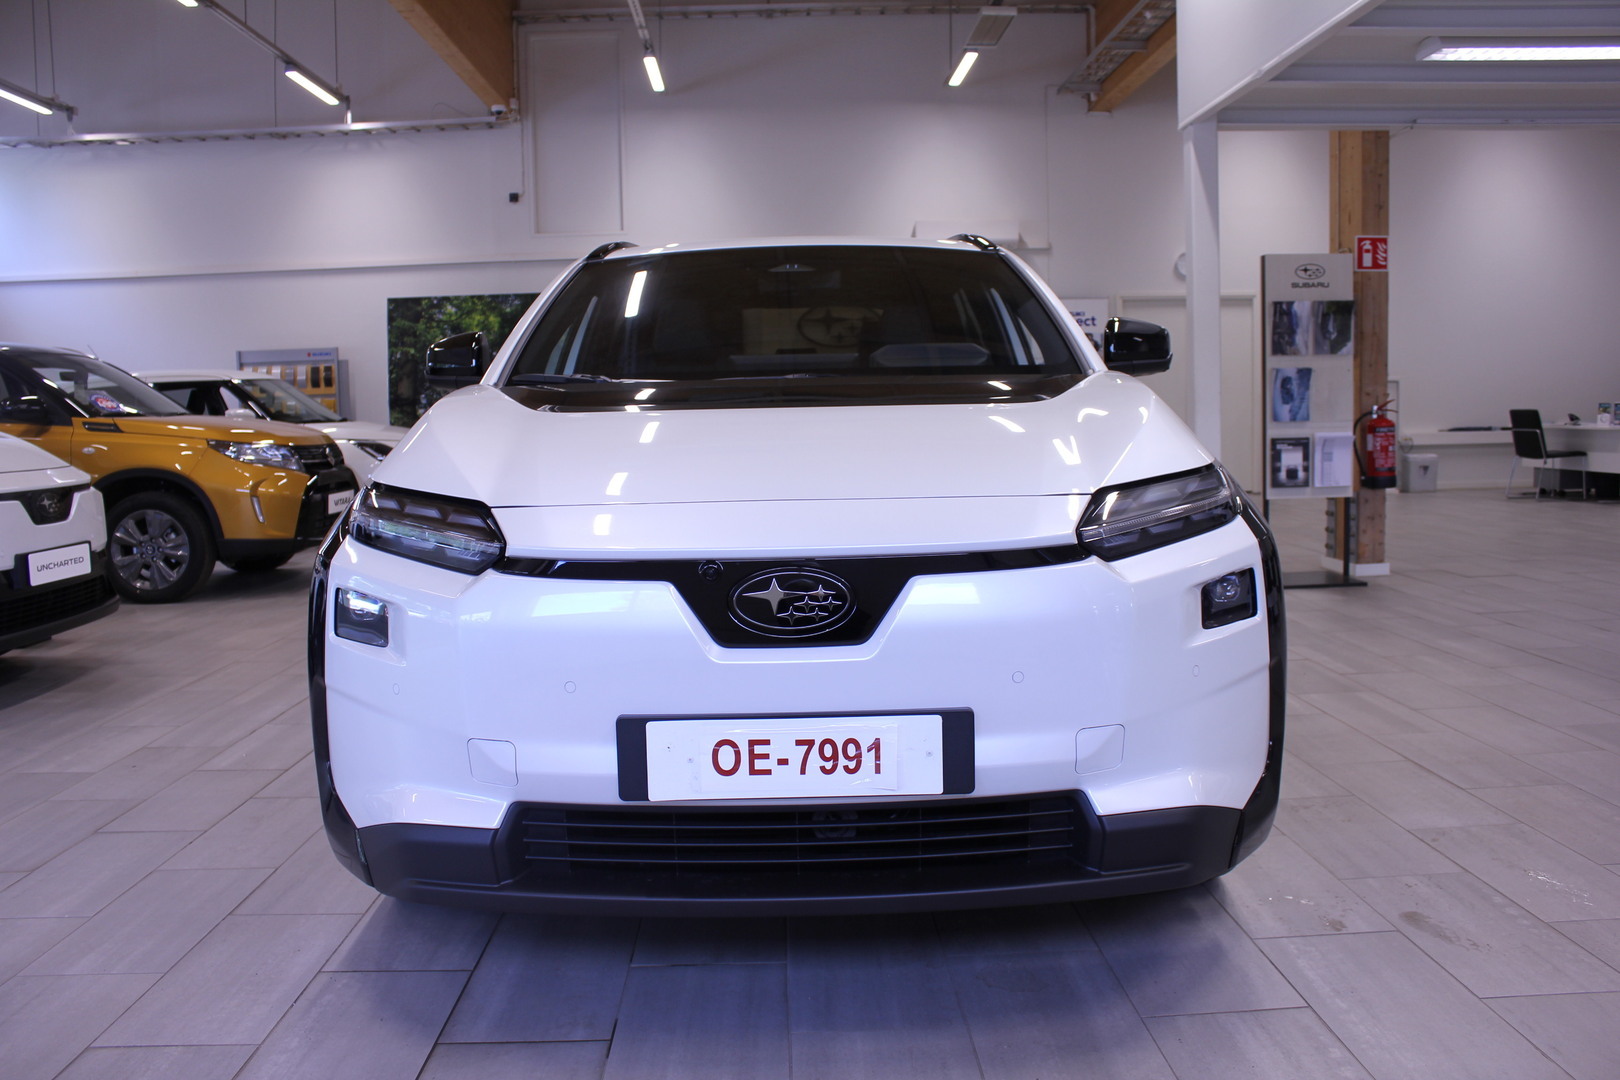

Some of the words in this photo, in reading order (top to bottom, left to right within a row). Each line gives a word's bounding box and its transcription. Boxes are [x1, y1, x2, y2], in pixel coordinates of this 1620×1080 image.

[1291, 281, 1330, 289] SUBARU
[36, 556, 85, 572] UNCHARTED
[711, 737, 881, 777] OE-7991
